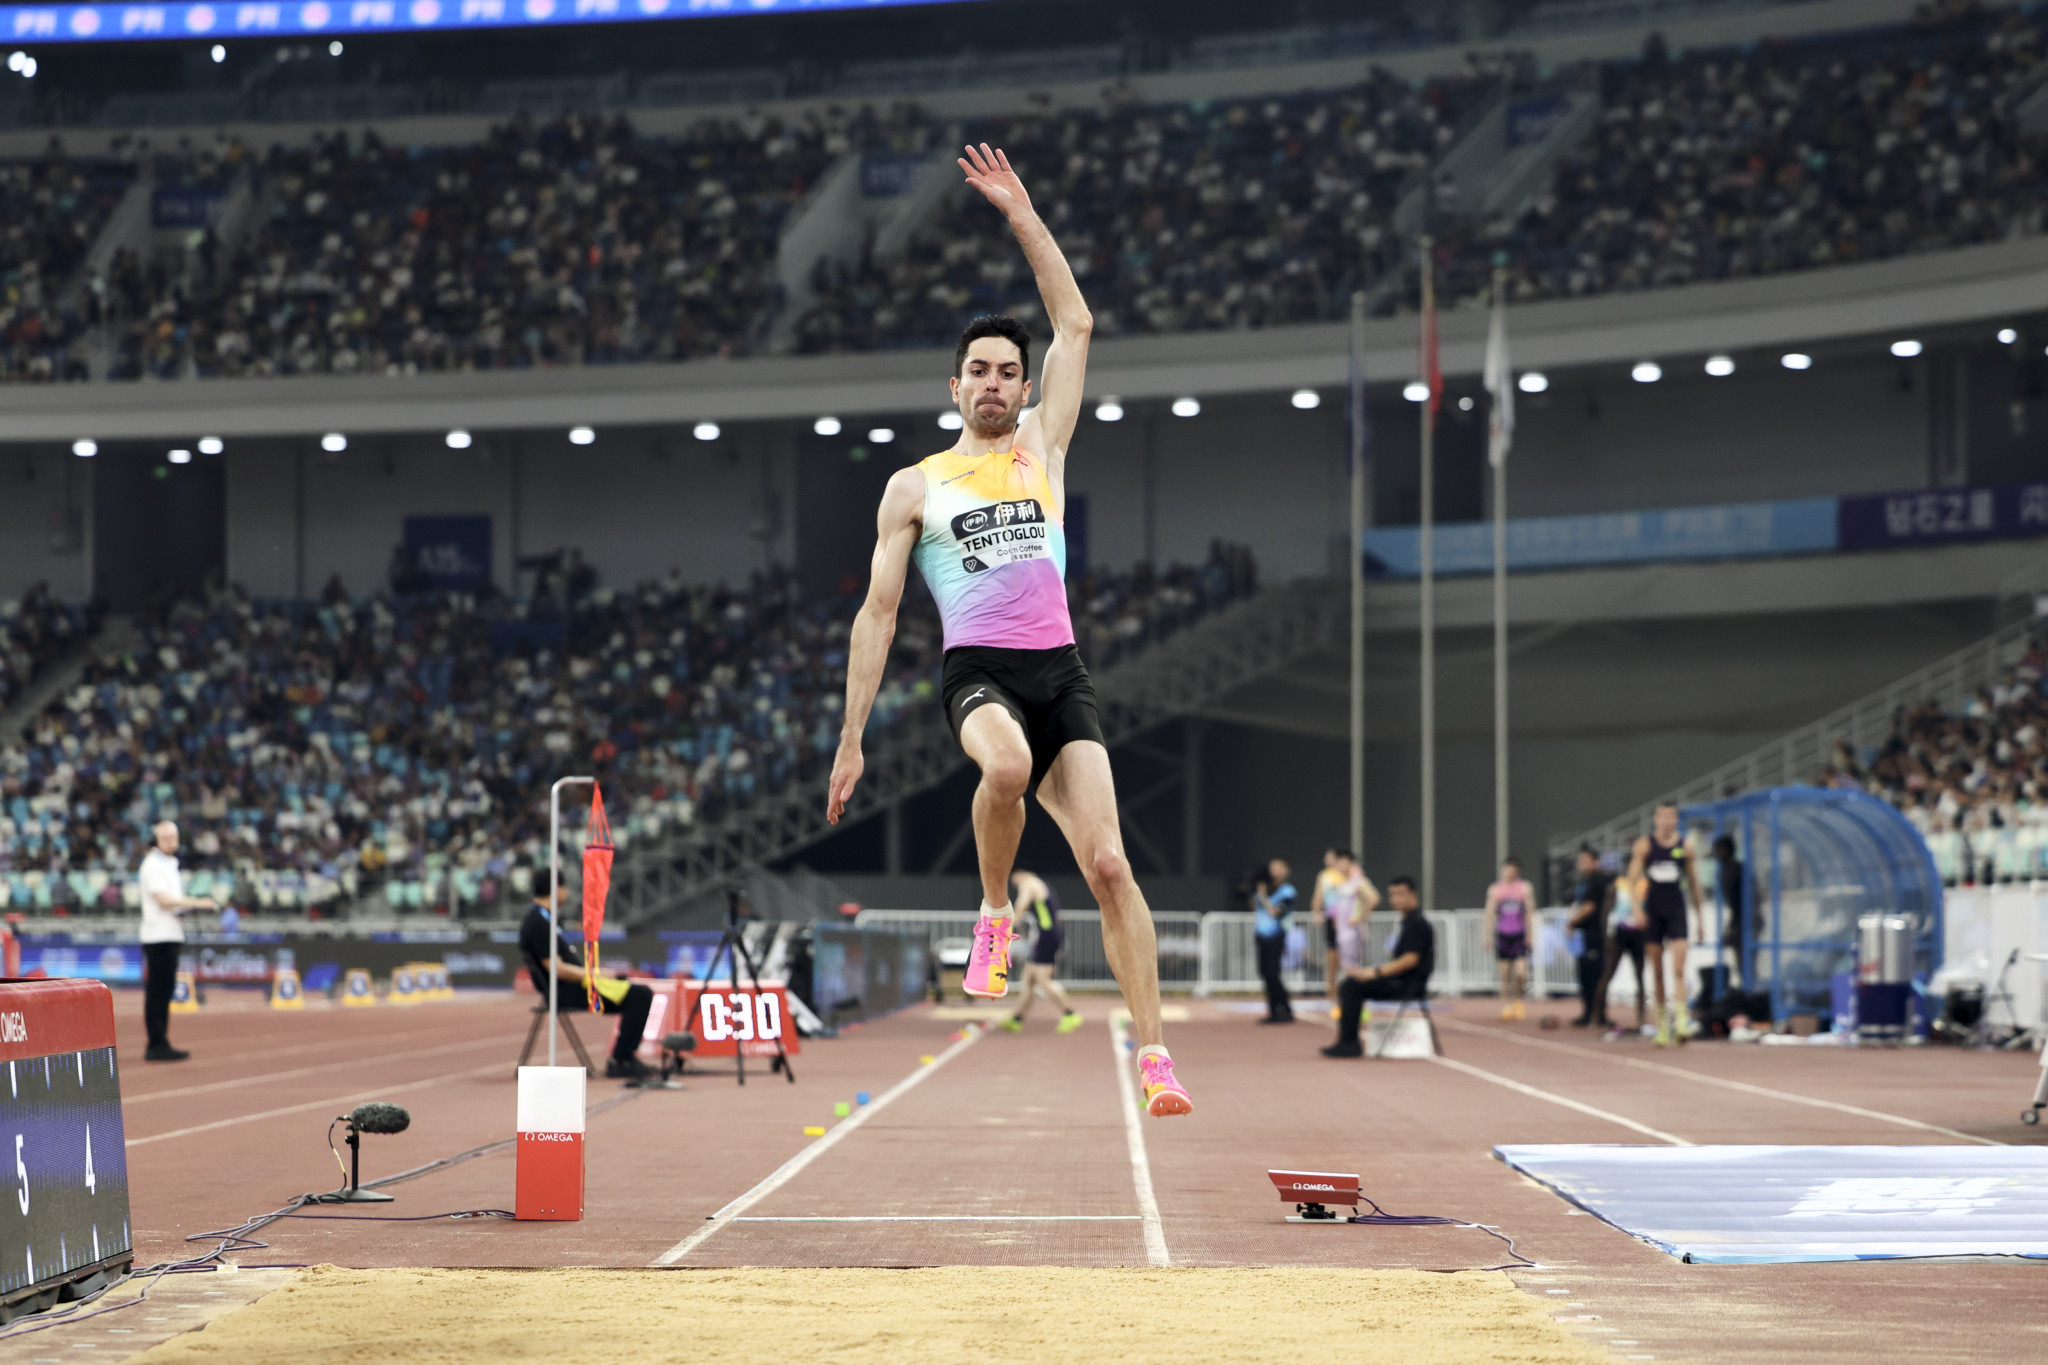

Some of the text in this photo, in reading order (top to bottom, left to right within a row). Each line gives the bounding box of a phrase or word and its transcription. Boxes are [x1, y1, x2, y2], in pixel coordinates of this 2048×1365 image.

[993, 500, 1037, 526] 伊利
[963, 526, 1045, 553] TENTOGLOU
[996, 547, 1019, 557] Coti
[1019, 544, 1043, 553] Coffee
[1, 1011, 28, 1043] OMEGA
[700, 993, 781, 1040] 0:30
[537, 1132, 574, 1142] OMEGA
[15, 1121, 95, 1217] 5 4
[1302, 1183, 1335, 1191] OMEGA
